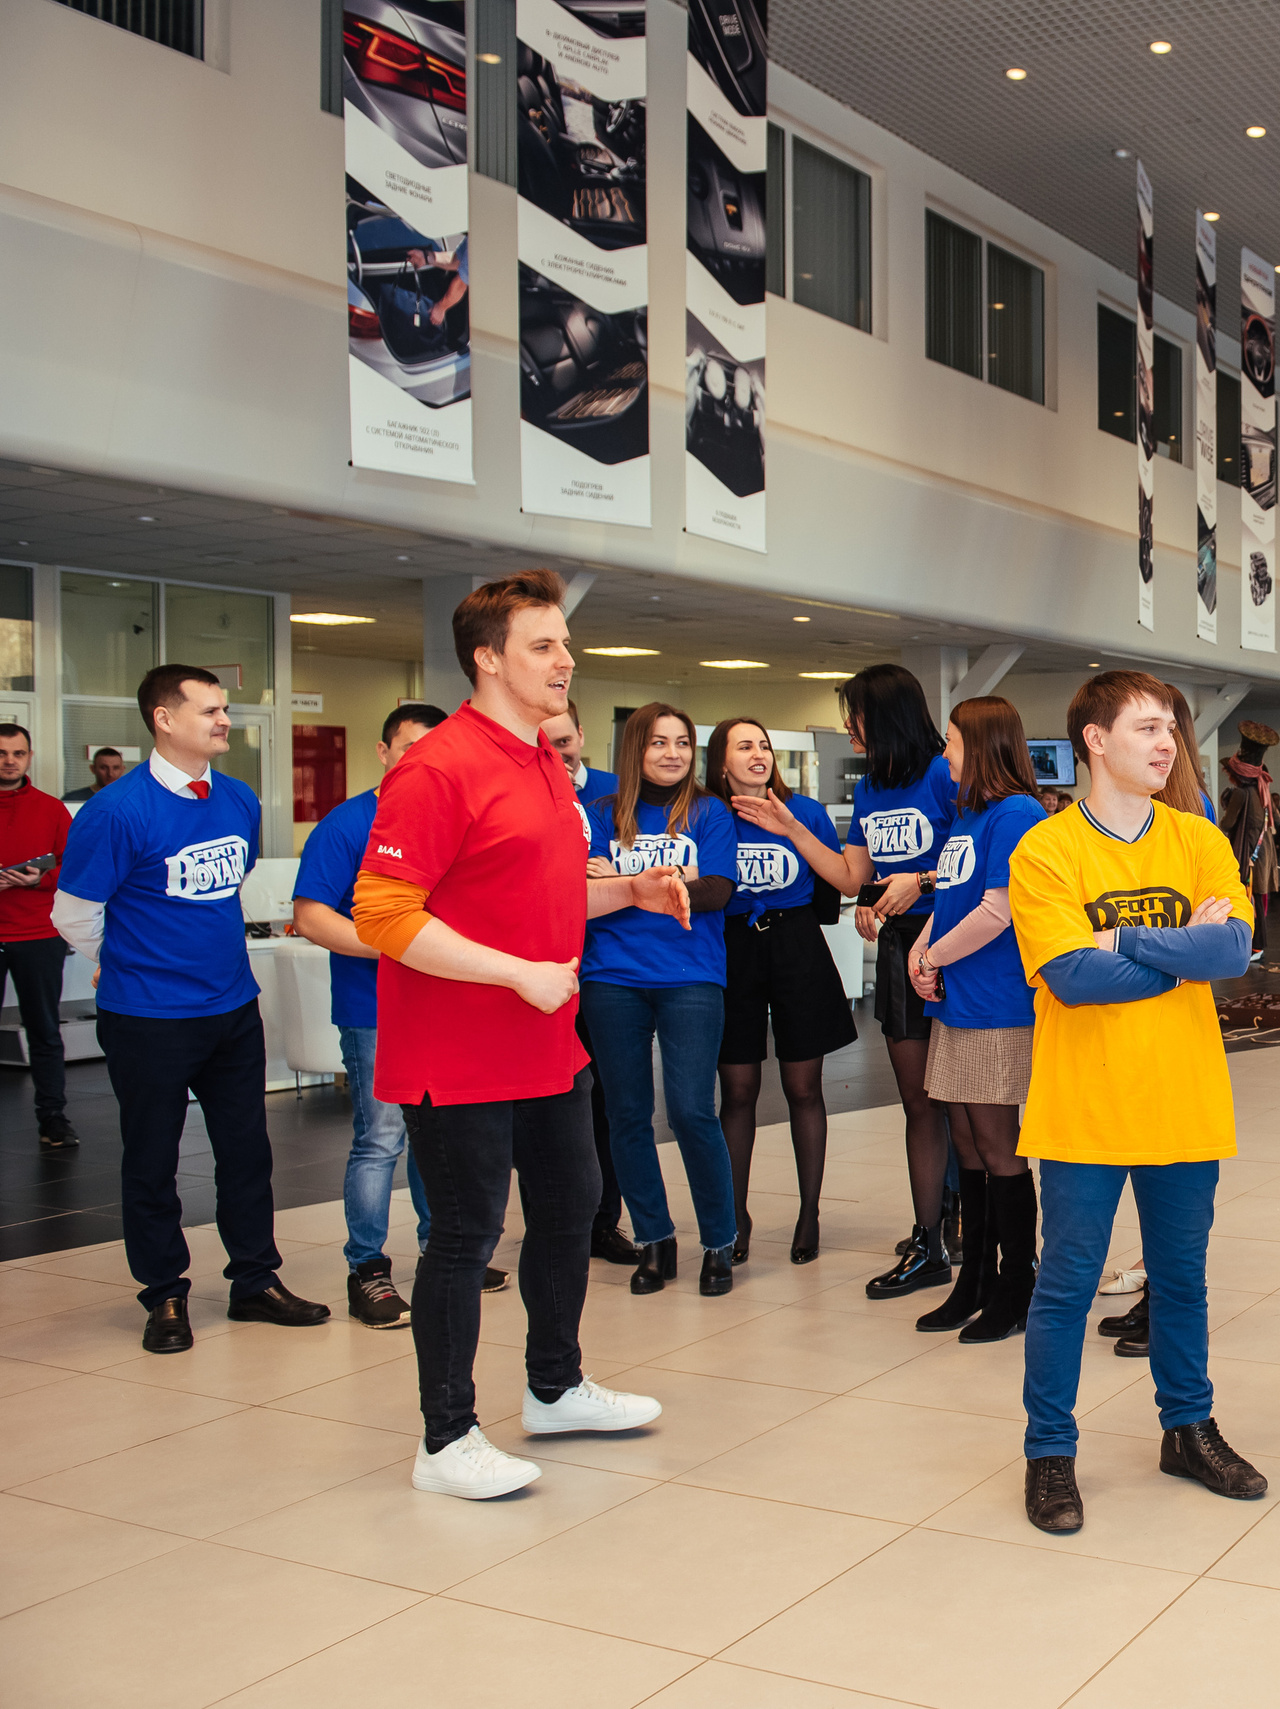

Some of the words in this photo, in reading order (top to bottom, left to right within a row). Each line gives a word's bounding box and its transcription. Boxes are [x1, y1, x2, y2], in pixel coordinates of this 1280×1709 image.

[876, 814, 911, 828] FORT
[377, 844, 402, 859] ВЛАД
[632, 838, 676, 850] FORT
[192, 844, 234, 864] FORT
[737, 849, 774, 860] ORT
[737, 848, 799, 888] YARD
[1115, 897, 1158, 914] FORT
